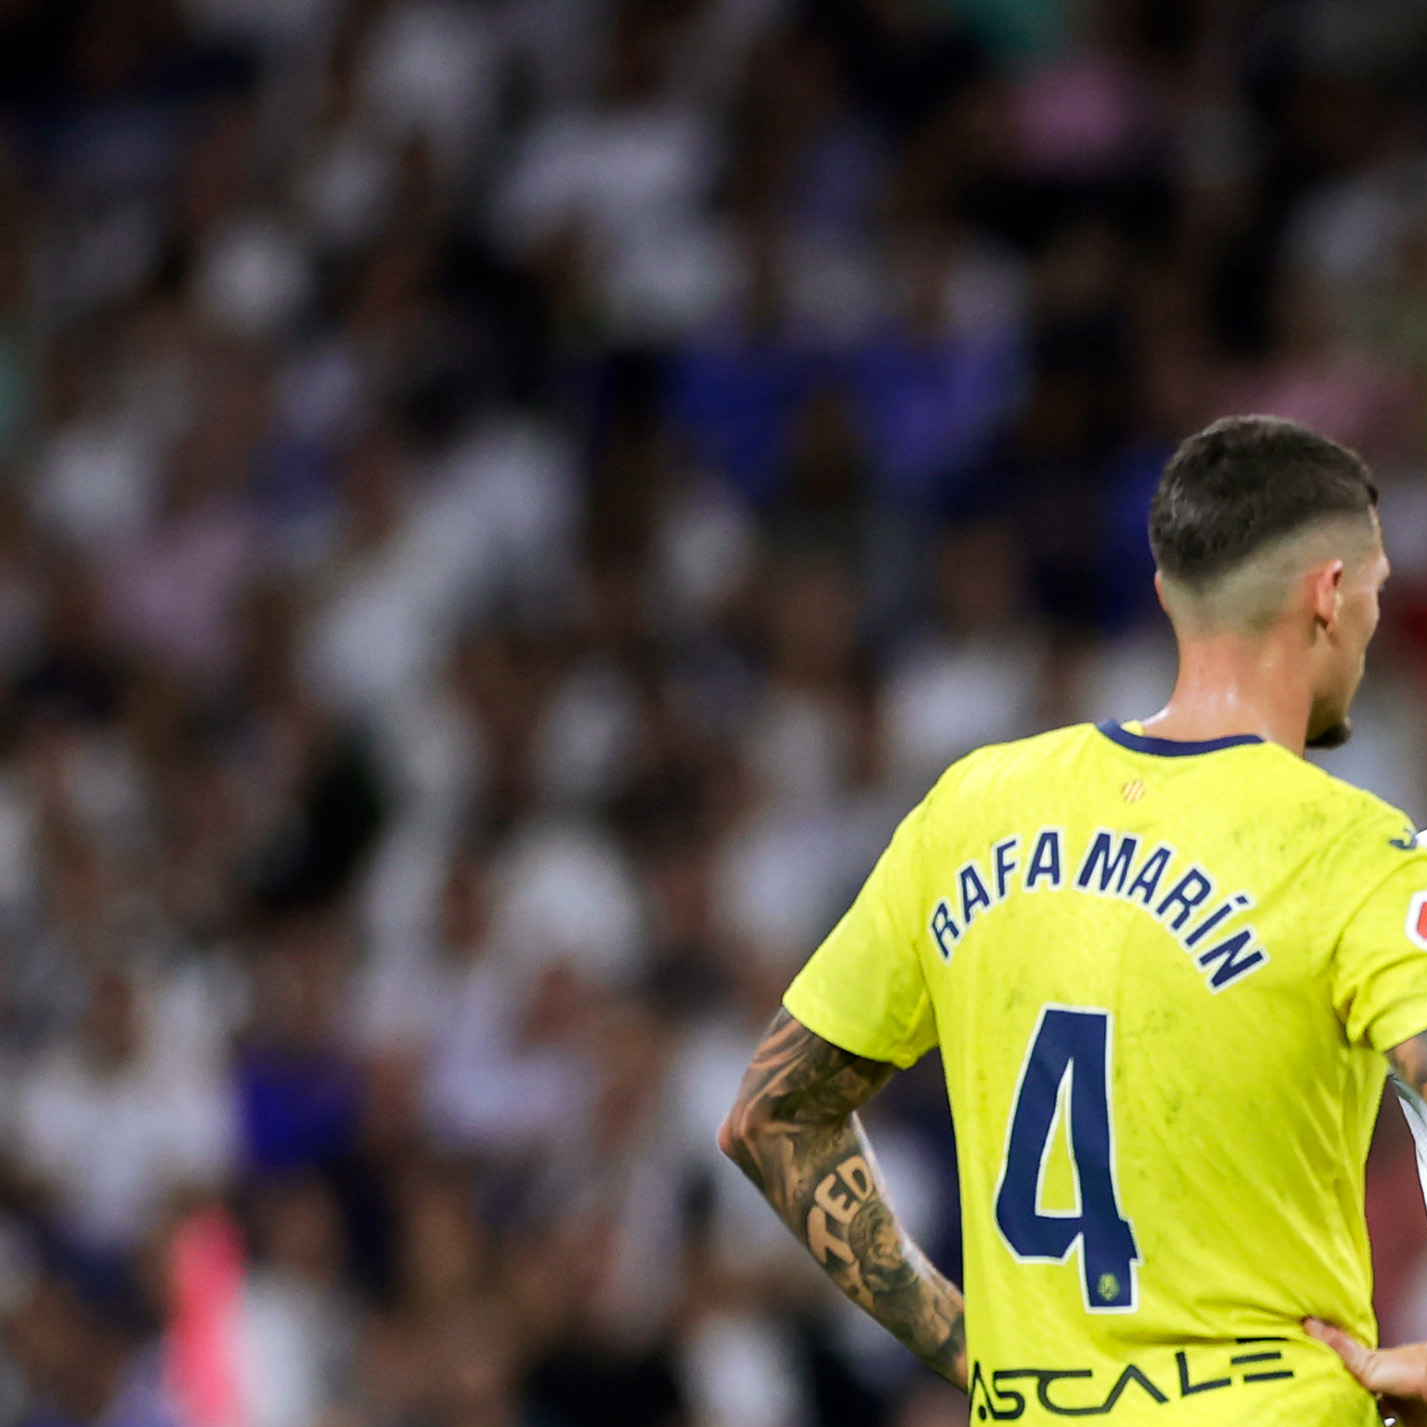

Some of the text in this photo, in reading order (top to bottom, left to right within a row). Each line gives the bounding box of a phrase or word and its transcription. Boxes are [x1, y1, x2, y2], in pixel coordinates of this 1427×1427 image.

[930, 828, 1267, 992] RAFA MARÍN
[995, 1004, 1139, 1312] 4
